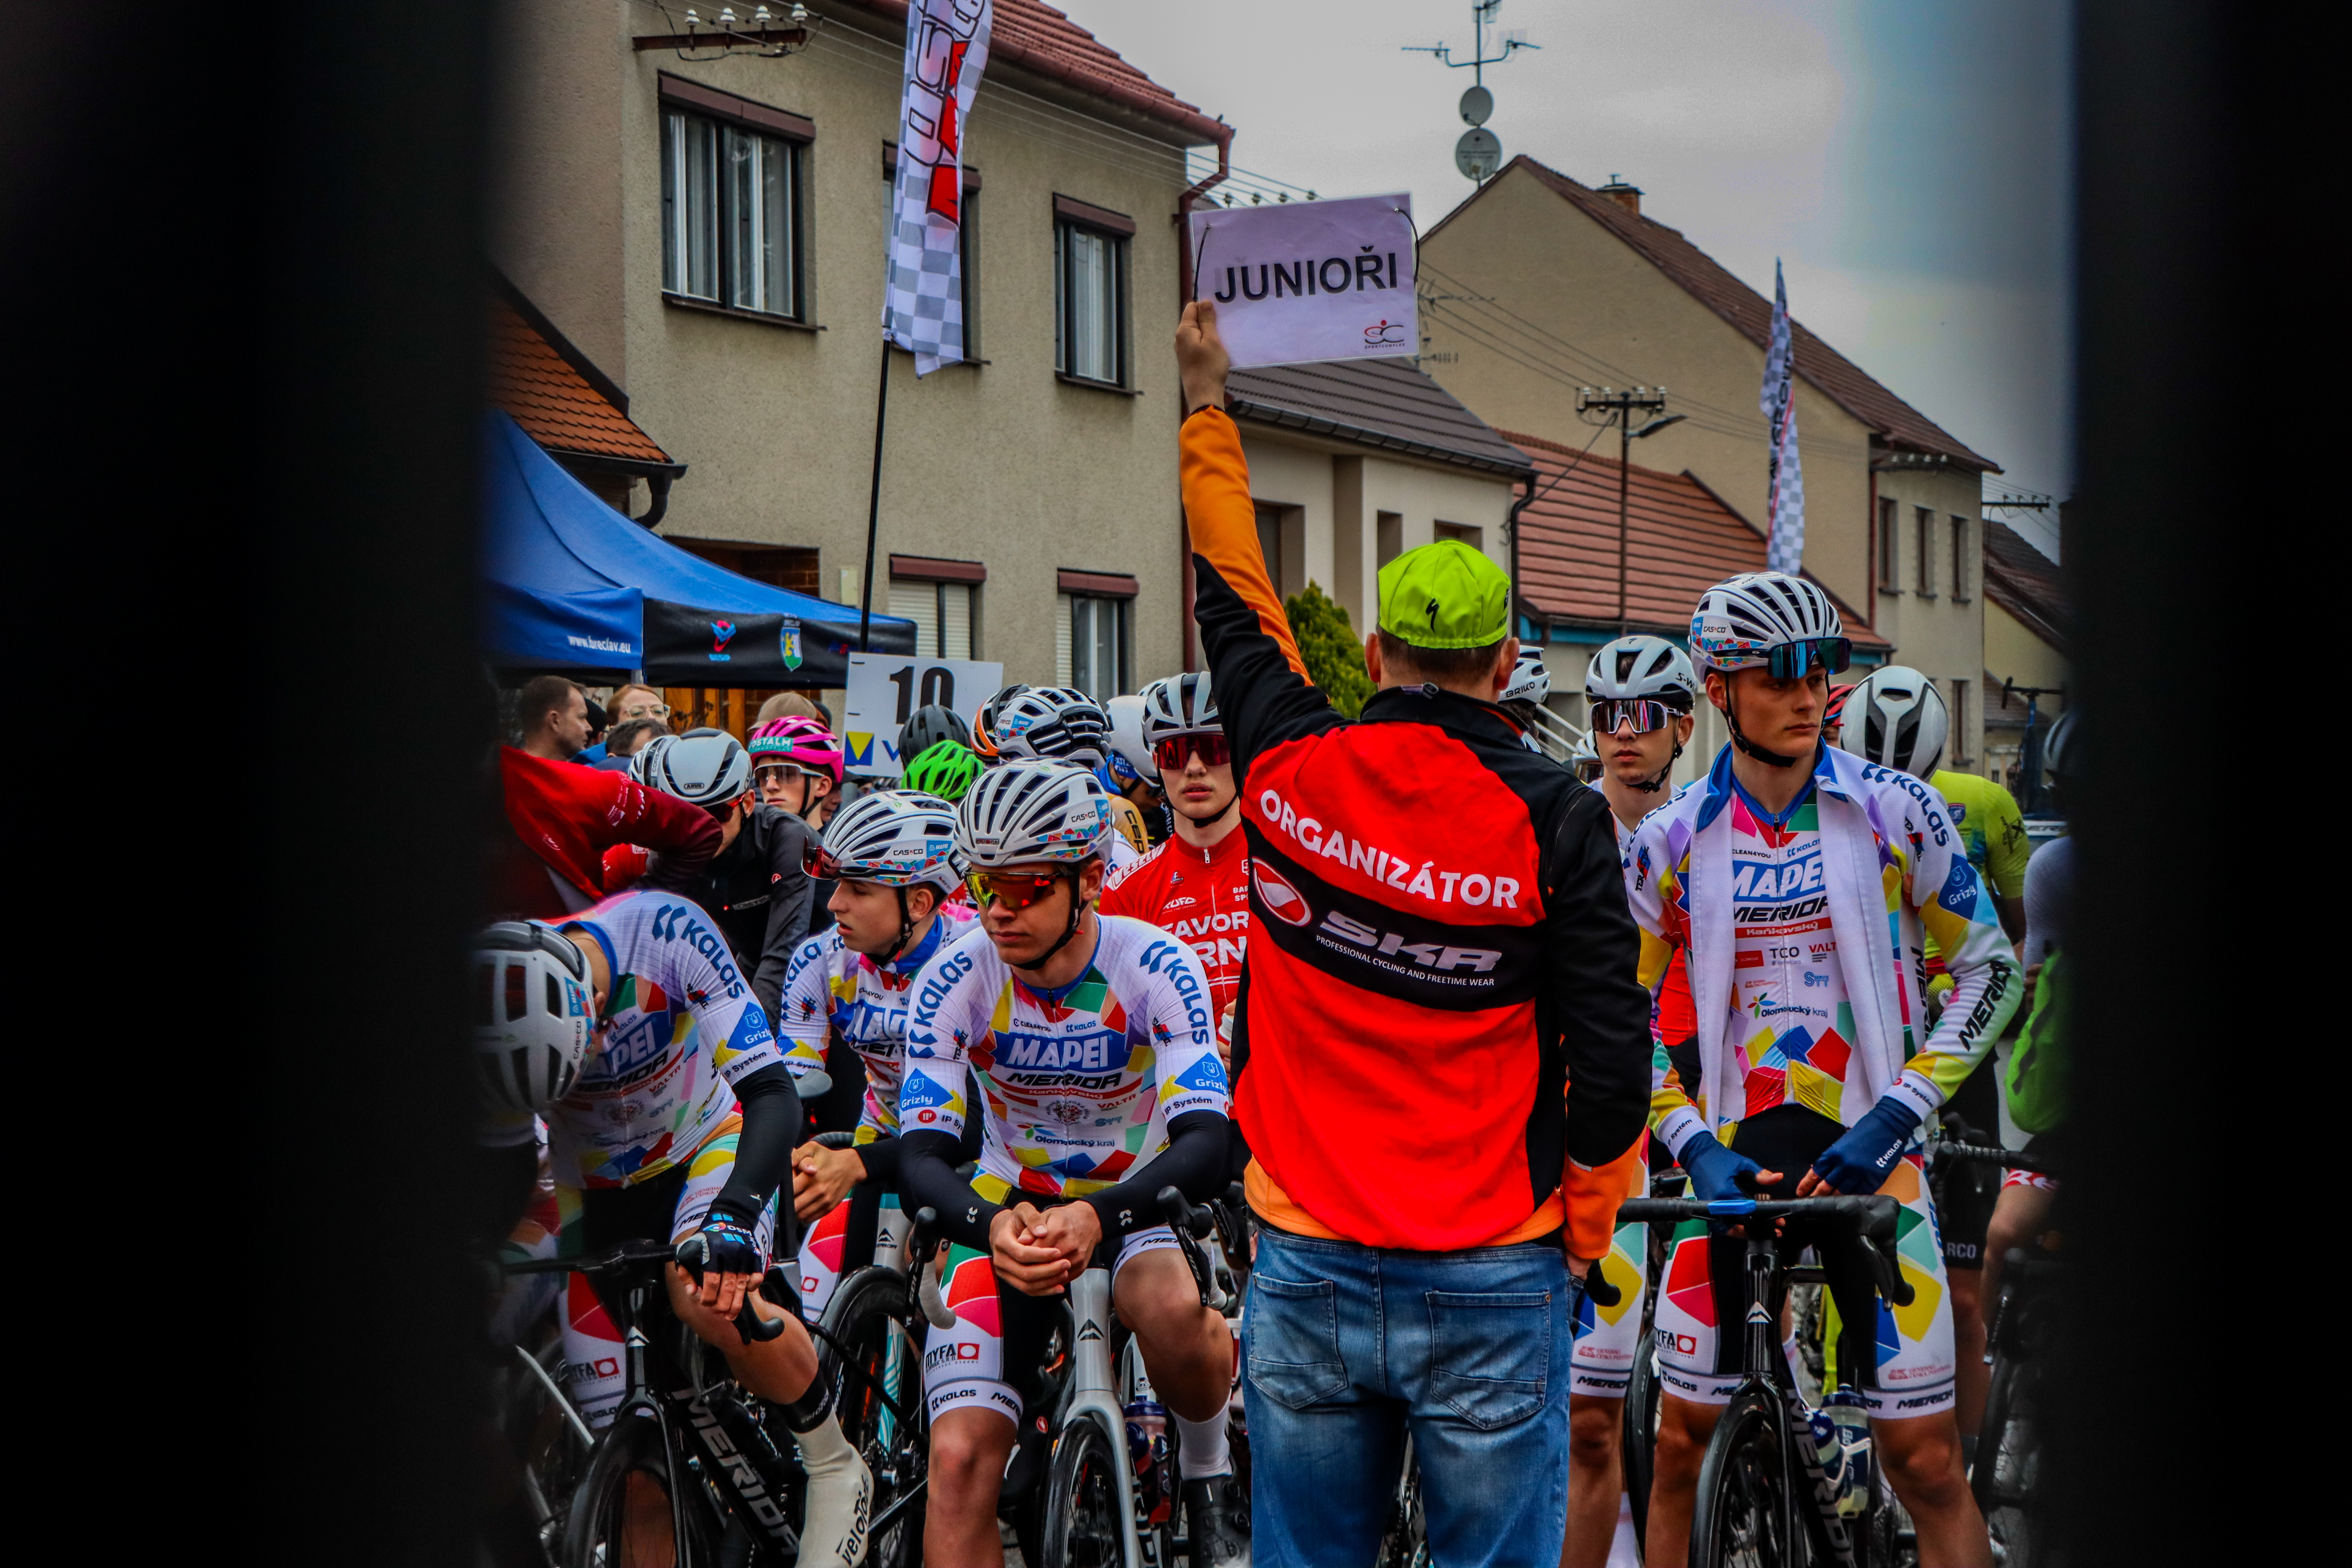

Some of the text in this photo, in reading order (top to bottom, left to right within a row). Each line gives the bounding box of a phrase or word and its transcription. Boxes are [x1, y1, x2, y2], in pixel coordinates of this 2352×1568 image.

[1215, 245, 1397, 303] JUNIOŘI
[567, 635, 631, 653] www.breclav.eu
[889, 665, 955, 724] 10
[1506, 682, 1535, 698] BRIKO
[1260, 789, 1520, 909] ORGANIZÁTOR
[1769, 946, 1800, 959] TCO
[1808, 942, 1837, 953] VALT
[1316, 935, 1495, 987] PROFESSIONAL CYCLING AND FREETIME WEAR
[1761, 1006, 1828, 1018] Olomoucký kraj
[1020, 1022, 1051, 1032] CLEAN4YOU
[1006, 1035, 1109, 1069] MAPEI
[731, 1051, 767, 1073] Systém
[1006, 1072, 1122, 1089] MERIDA
[1195, 1079, 1227, 1094] Grizly
[902, 1096, 933, 1108] Grizly
[1097, 1094, 1136, 1108] VALTR
[1164, 1097, 1212, 1115] IP Systém
[1670, 1118, 1693, 1138] Systém
[727, 1225, 752, 1236] DSM
[671, 1388, 801, 1556] MERIDA
